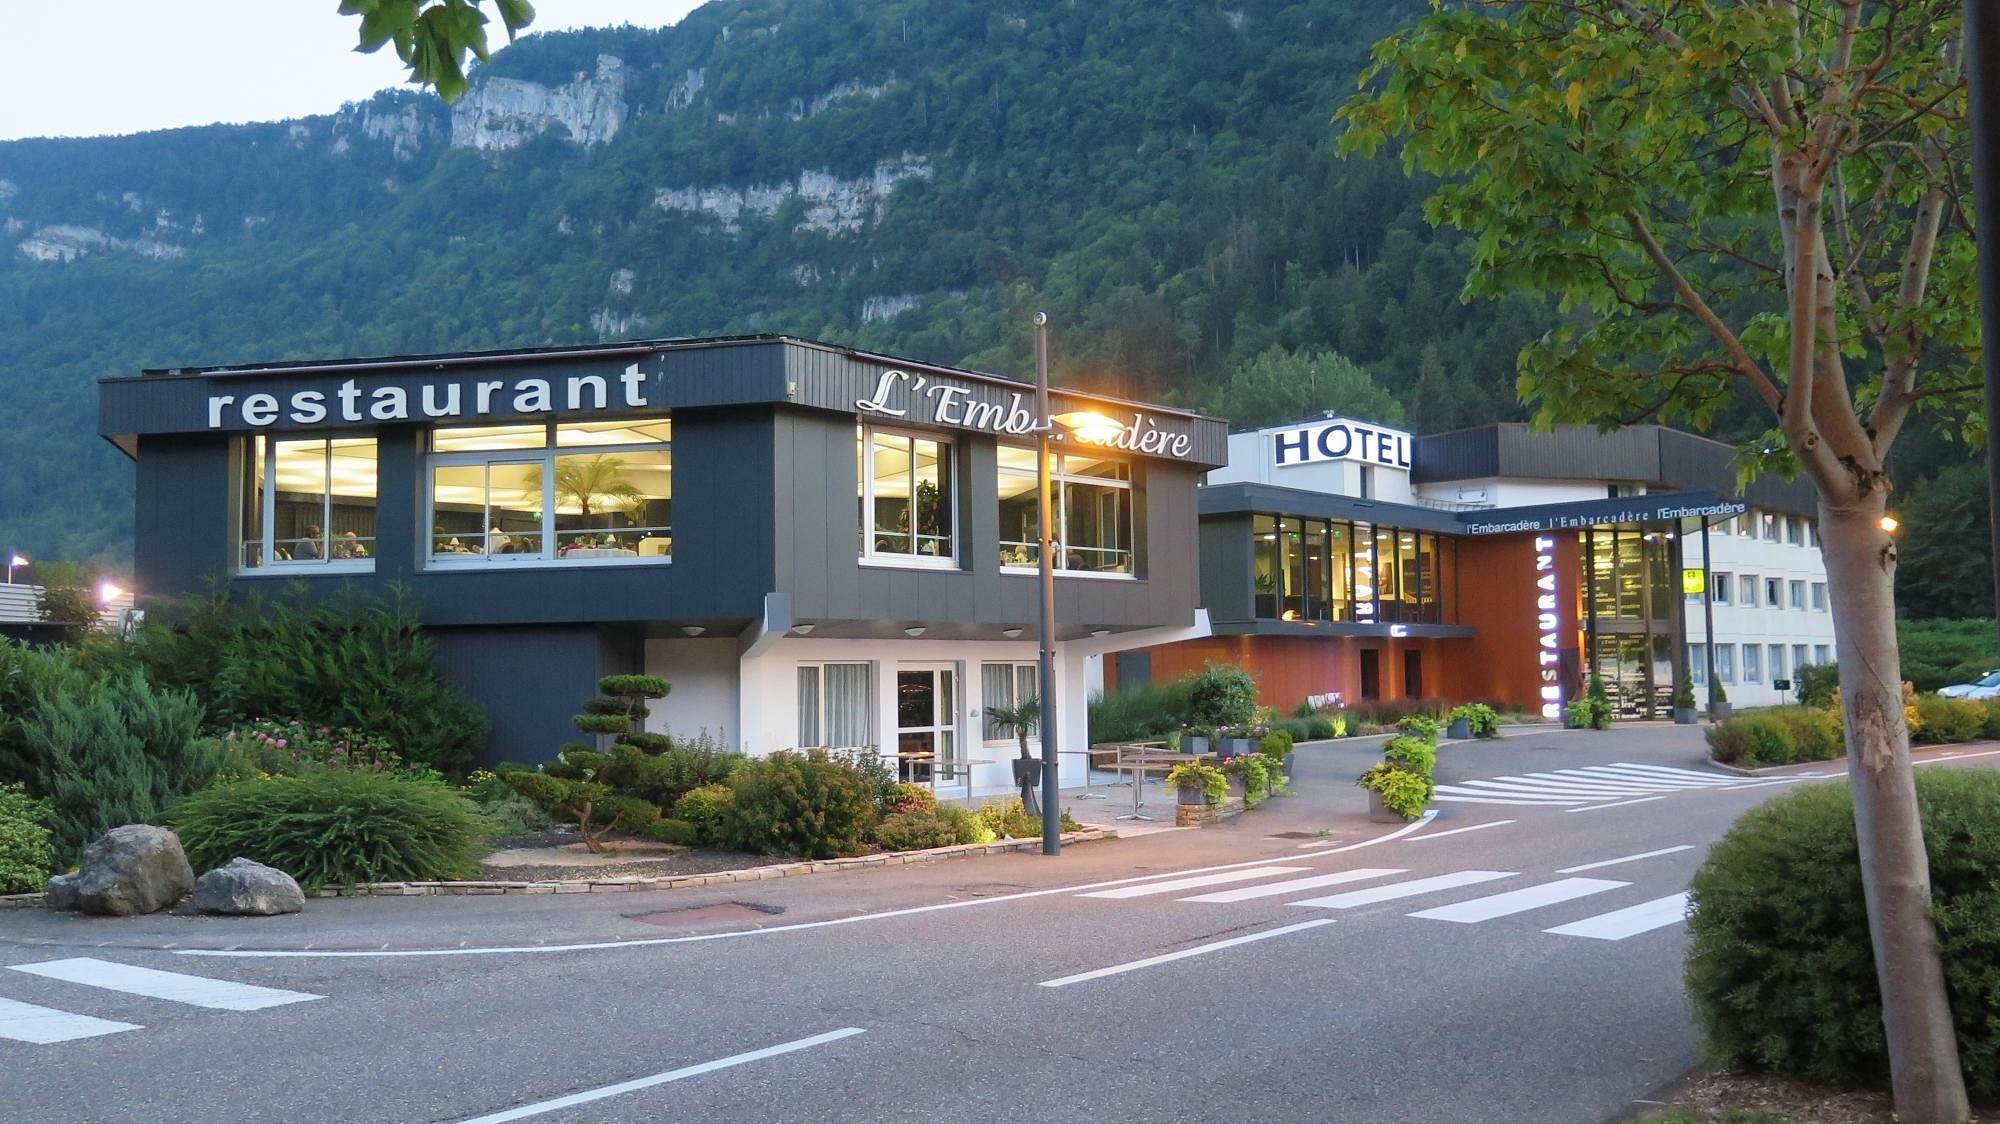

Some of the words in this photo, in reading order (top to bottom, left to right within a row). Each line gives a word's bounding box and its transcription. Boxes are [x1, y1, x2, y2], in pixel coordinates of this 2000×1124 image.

[208, 362, 648, 428] restaurant
[855, 370, 1192, 457] L'Embdère
[1275, 424, 1410, 468] HOTEL
[1466, 519, 1540, 534] l'Embarcadère
[1549, 511, 1649, 528] l'Embarcadère
[1656, 502, 1746, 520] l'Embarcadère
[1535, 536, 1560, 719] RESTAURANT
